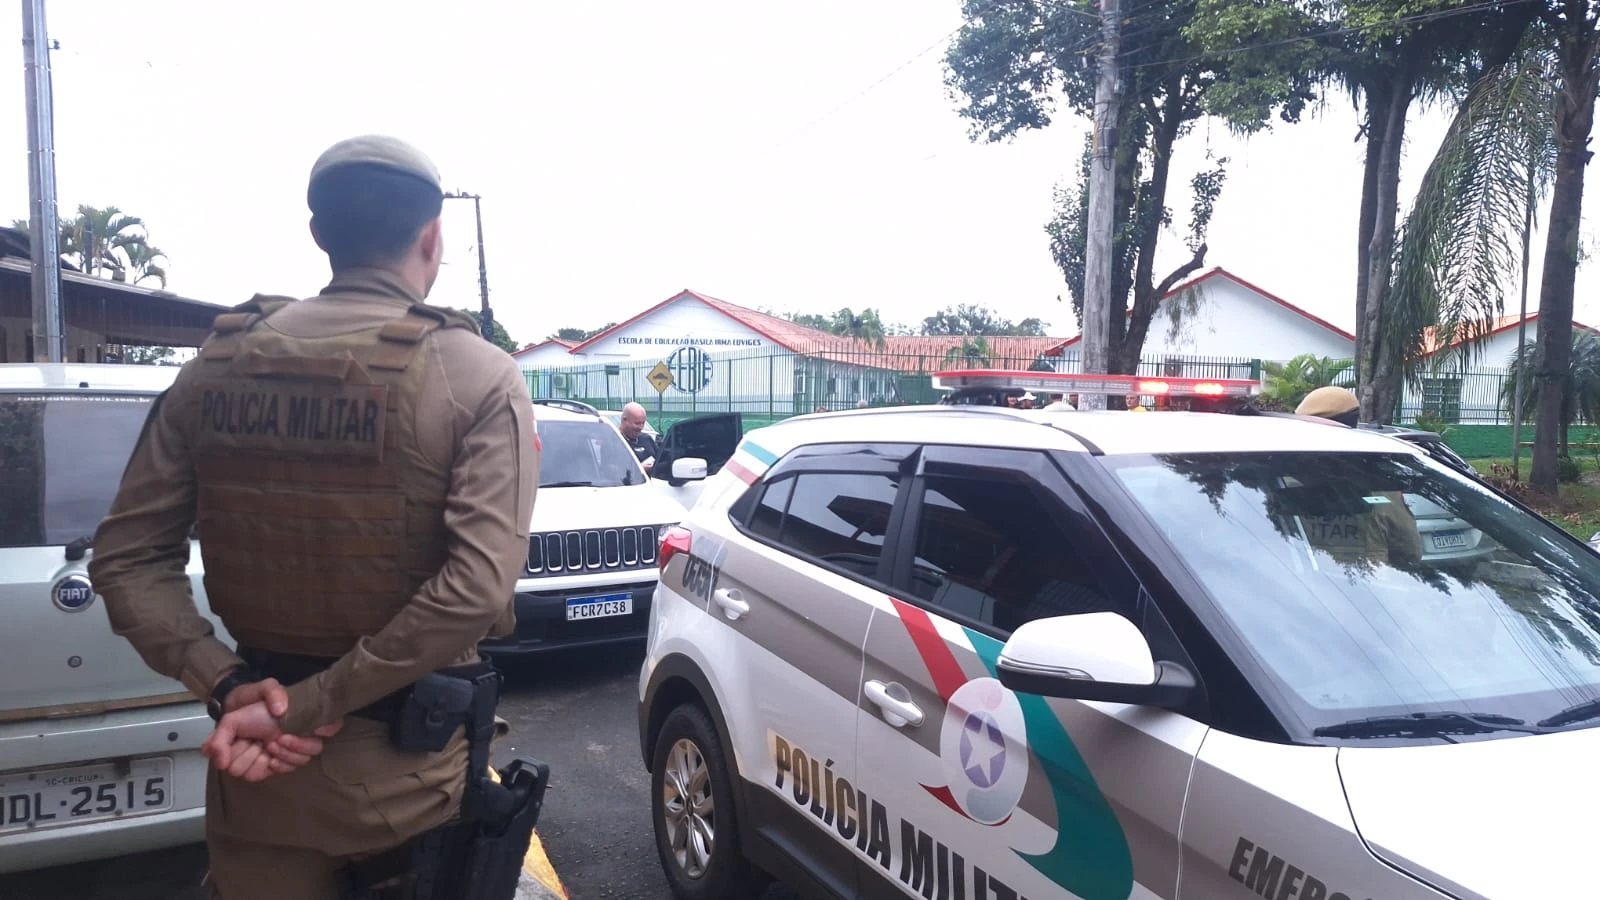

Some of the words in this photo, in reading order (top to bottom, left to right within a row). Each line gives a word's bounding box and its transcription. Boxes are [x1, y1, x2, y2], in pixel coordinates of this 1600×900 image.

[618, 337, 644, 345] ESCOLA
[288, 394, 379, 442] MILITAR
[60, 587, 89, 600] FIAT
[572, 601, 627, 619] FCR7C38
[775, 734, 891, 871] POLÍCIA
